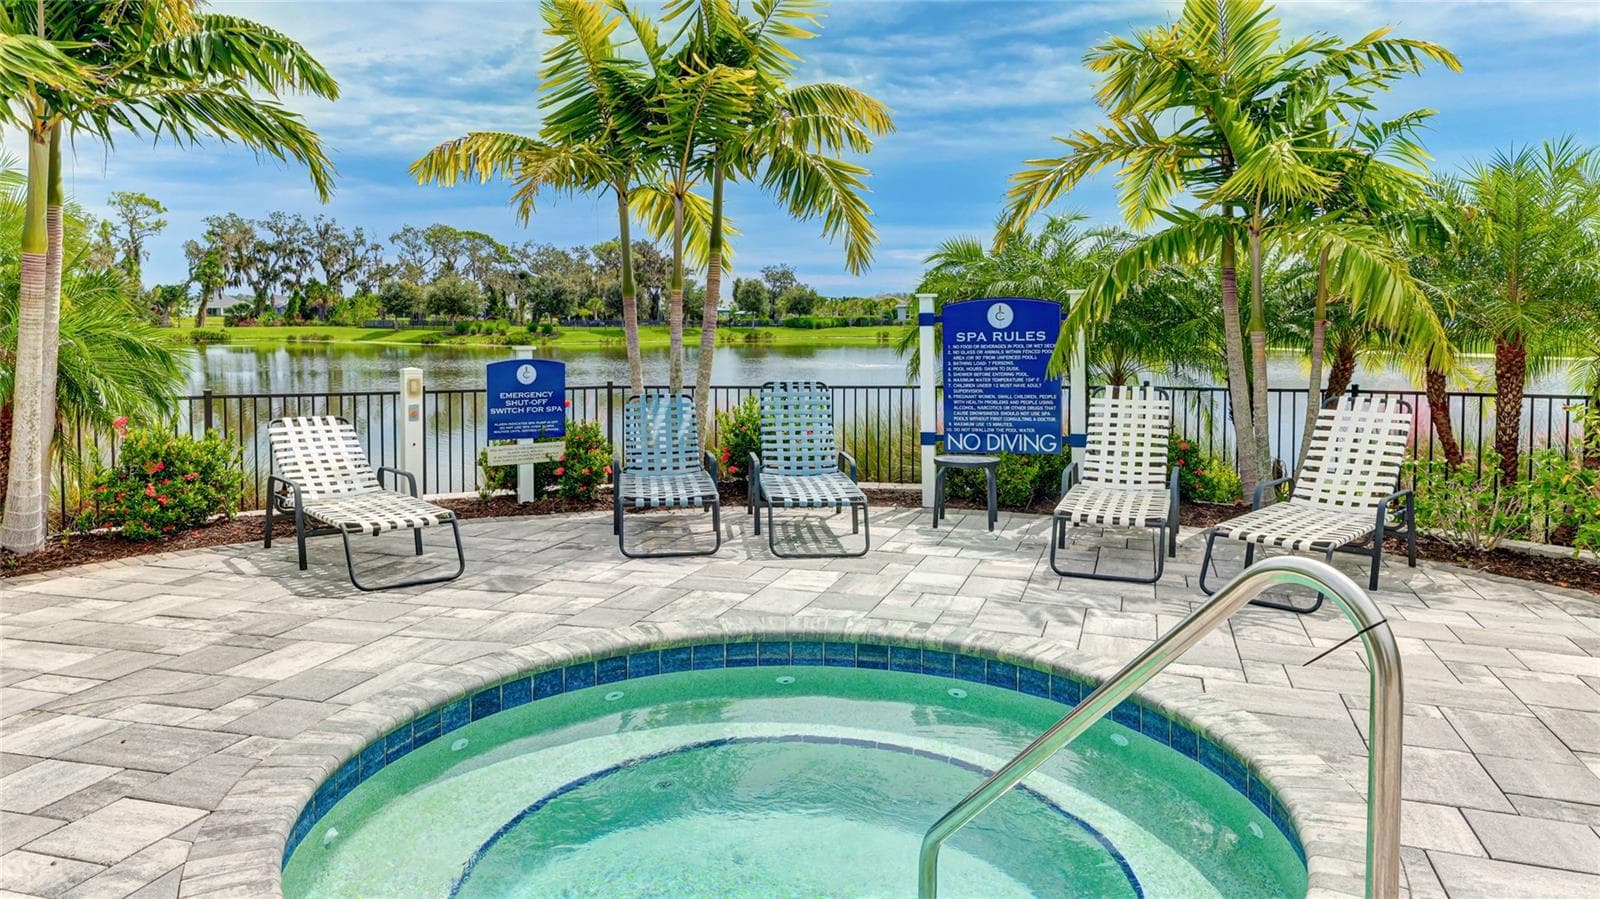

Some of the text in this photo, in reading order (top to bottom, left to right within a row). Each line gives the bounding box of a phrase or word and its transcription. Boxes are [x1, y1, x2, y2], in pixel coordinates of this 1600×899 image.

[956, 331, 1047, 342] SPA RULES
[500, 391, 553, 399] EMERGENCY
[947, 433, 1057, 452] NO DIVING
